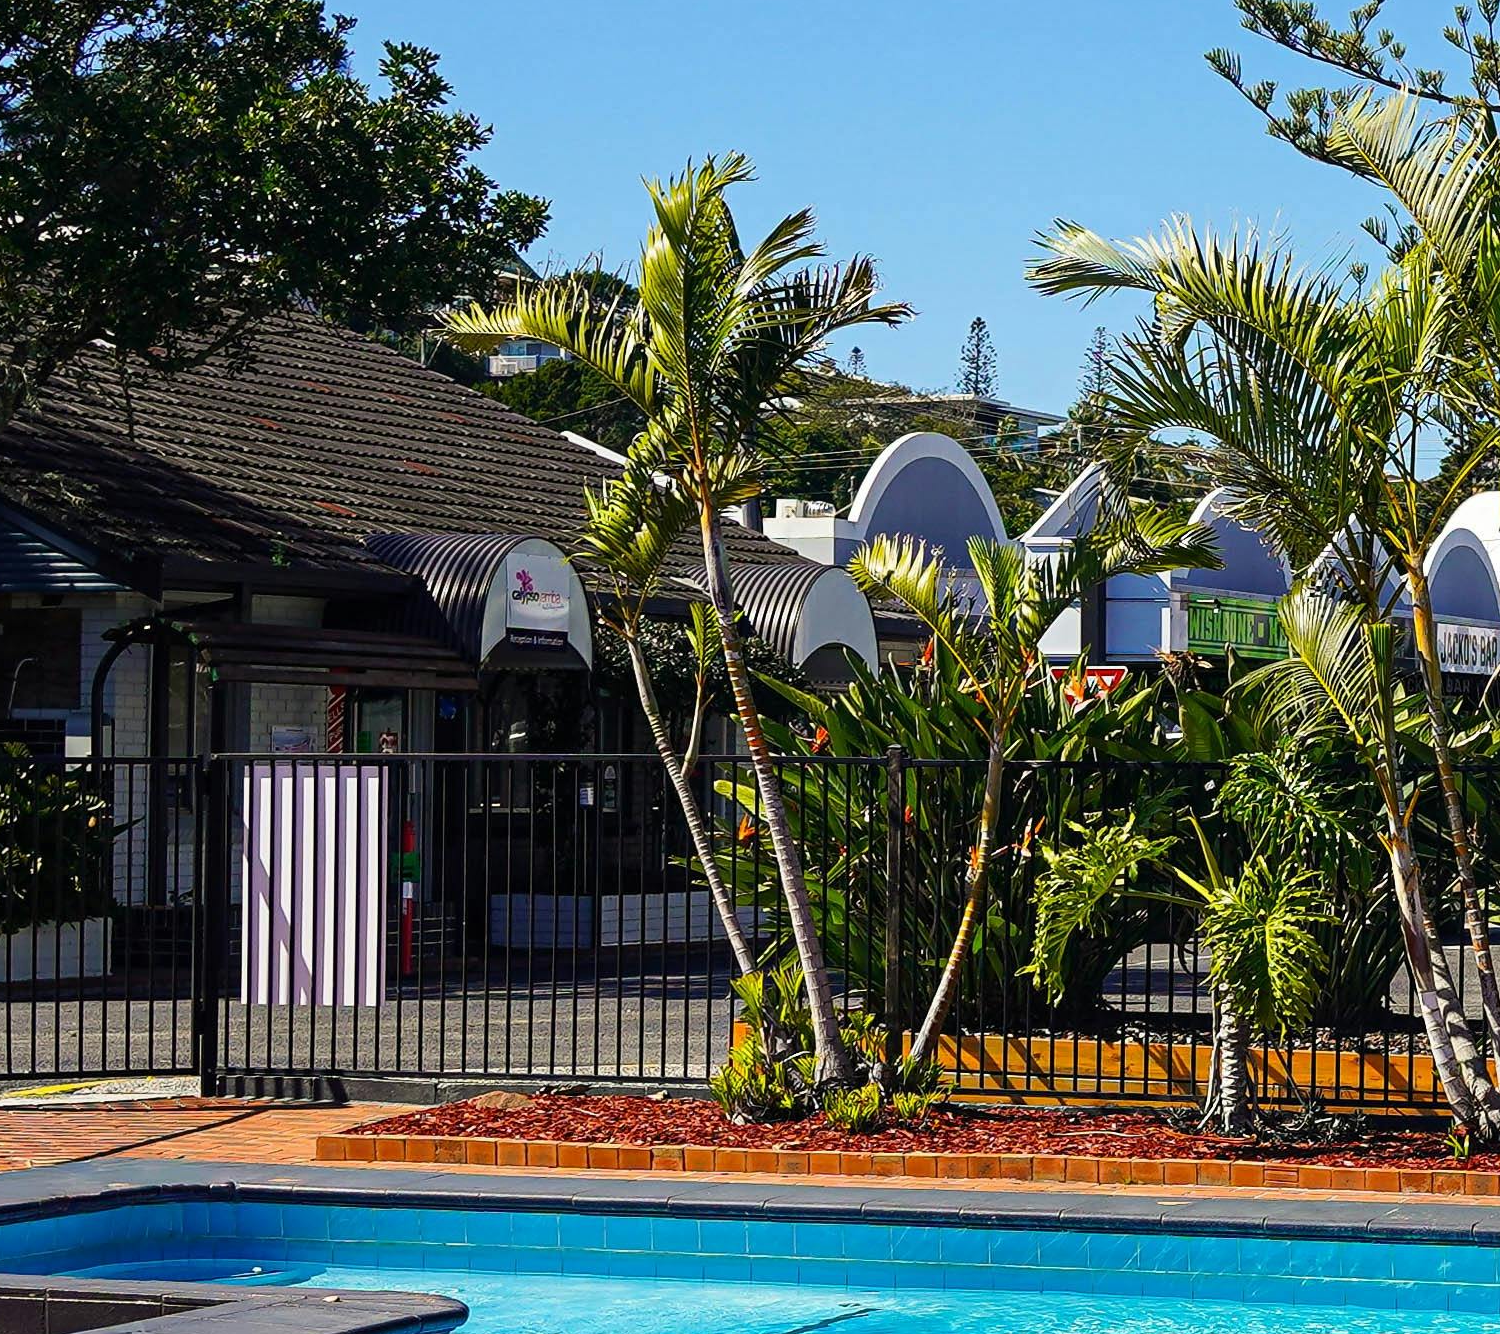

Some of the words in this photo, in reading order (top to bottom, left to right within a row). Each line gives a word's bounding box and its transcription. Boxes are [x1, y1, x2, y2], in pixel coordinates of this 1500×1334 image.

[1190, 608, 1255, 644] WISHBONE
[1440, 631, 1478, 666] JACKO'S
[1480, 636, 1498, 667] BAR
